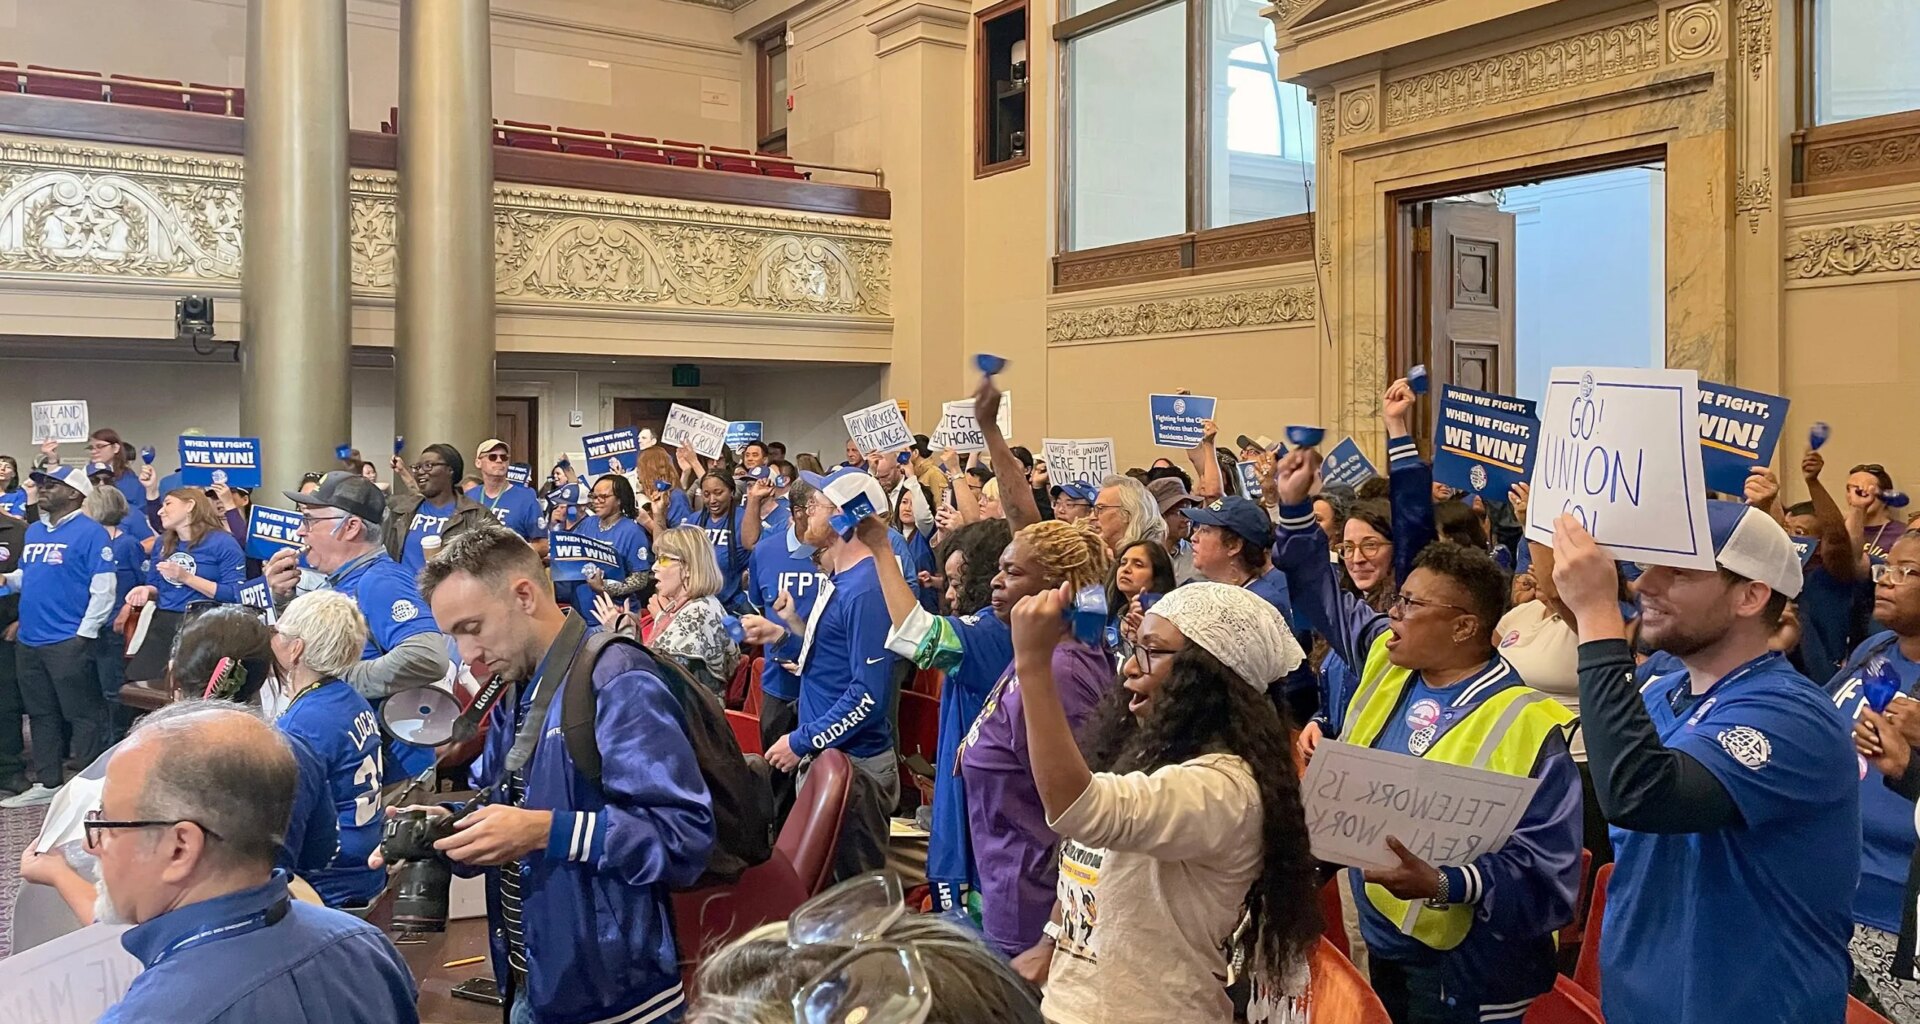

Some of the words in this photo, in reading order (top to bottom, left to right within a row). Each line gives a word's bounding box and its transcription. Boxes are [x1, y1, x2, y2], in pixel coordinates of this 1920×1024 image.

[1447, 389, 1473, 403] WHEN
[1474, 395, 1491, 407] WE
[1491, 399, 1527, 414] FIGHT,
[1715, 393, 1770, 419] FIGHT,
[1445, 407, 1473, 424] WHEN
[1474, 413, 1491, 429] WE
[1491, 418, 1530, 439] FIGHT,
[1570, 396, 1604, 440] GO!
[184, 439, 209, 448] WHEN
[210, 440, 225, 449] WE
[587, 444, 607, 457] WE
[606, 438, 635, 453] WIN!
[1444, 425, 1473, 451] WE
[1475, 433, 1527, 466] WIN!
[184, 450, 211, 464] WE
[212, 451, 254, 465] WIN!
[1077, 454, 1108, 471] THE
[1544, 432, 1643, 506] UNION
[258, 510, 285, 523] WHEN
[285, 515, 301, 526] WE
[256, 521, 284, 539] WE
[555, 535, 581, 543] WHEN
[555, 545, 582, 558] WE
[584, 546, 618, 565] WIN!
